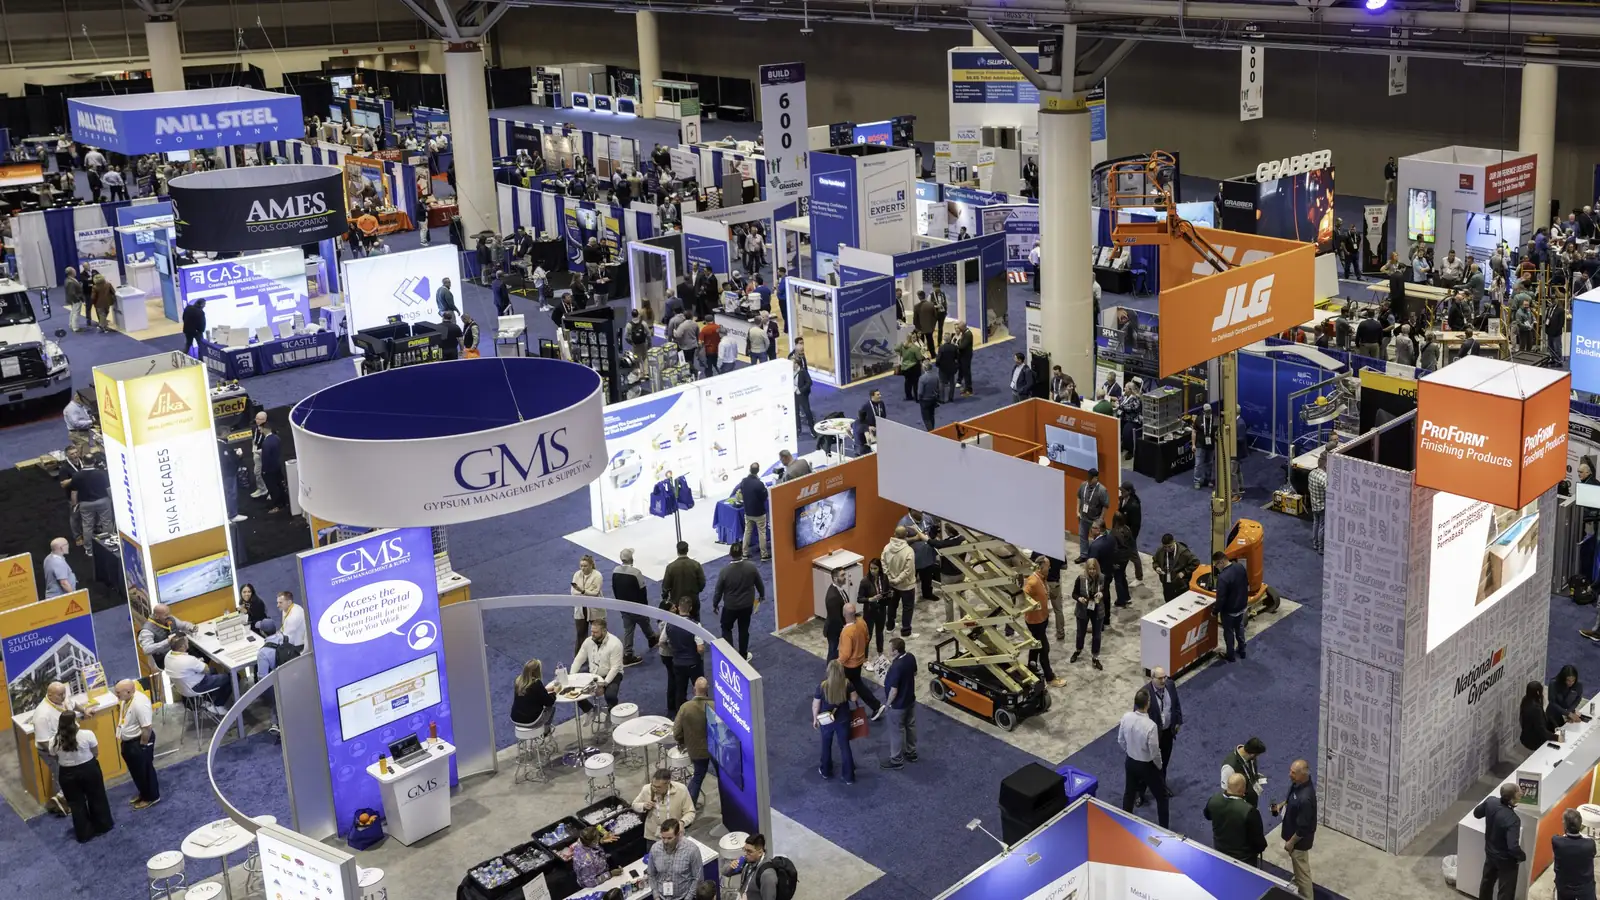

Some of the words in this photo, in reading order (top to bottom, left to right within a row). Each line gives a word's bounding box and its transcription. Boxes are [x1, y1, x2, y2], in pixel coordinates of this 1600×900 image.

[767, 69, 790, 79] BUILD
[95, 114, 118, 135] STEEL
[155, 112, 217, 135] MILL
[216, 107, 278, 129] STEEL
[155, 126, 279, 145] COMPANY
[1256, 149, 1332, 183] GRABBER
[246, 192, 328, 222] AMES
[870, 202, 906, 216] EXPERTS
[1224, 199, 1254, 208] GRABBER
[247, 223, 276, 233] TOOLS
[275, 216, 329, 230] CORPORATION
[207, 260, 271, 283] CASTLE
[1212, 273, 1275, 332] JLG
[1235, 323, 1257, 336] Corporation
[288, 337, 317, 348] CASTLE
[1575, 347, 1600, 358] Buildin
[153, 392, 185, 415] Sika
[214, 399, 245, 415] eTech
[1056, 414, 1077, 426] JLG
[1420, 437, 1465, 460] Finishing
[1466, 447, 1513, 468] Products
[1545, 433, 1566, 454] Products
[454, 427, 569, 491] GMS
[1522, 447, 1545, 468] Finishing
[157, 448, 177, 503] FACADES
[423, 496, 471, 512] GYPSUM
[473, 479, 546, 505] MANAGEMENT
[547, 477, 555, 486] &
[797, 481, 821, 500] JLG
[166, 504, 181, 534] SIKA
[336, 536, 404, 576] GMS
[331, 574, 353, 586] GYPSUM
[353, 565, 389, 579] MANAGEMENT
[393, 557, 411, 567] SUPPLY
[330, 603, 378, 625] Customer
[380, 591, 410, 608] Portal
[343, 593, 377, 611] Access
[379, 587, 396, 598] the
[333, 619, 364, 634] Custom
[365, 611, 383, 624] Built
[384, 608, 395, 622] for
[395, 604, 409, 614] the
[345, 626, 363, 638] Way
[364, 621, 378, 630] You
[379, 614, 400, 626] Work
[7, 632, 39, 647] STUCCO
[9, 635, 53, 654] SOLUTIONS
[1180, 619, 1210, 652] JLG
[719, 660, 741, 694] GMS
[1453, 650, 1494, 699] National
[1467, 665, 1504, 705] Gypsum
[407, 777, 438, 799] GMS
